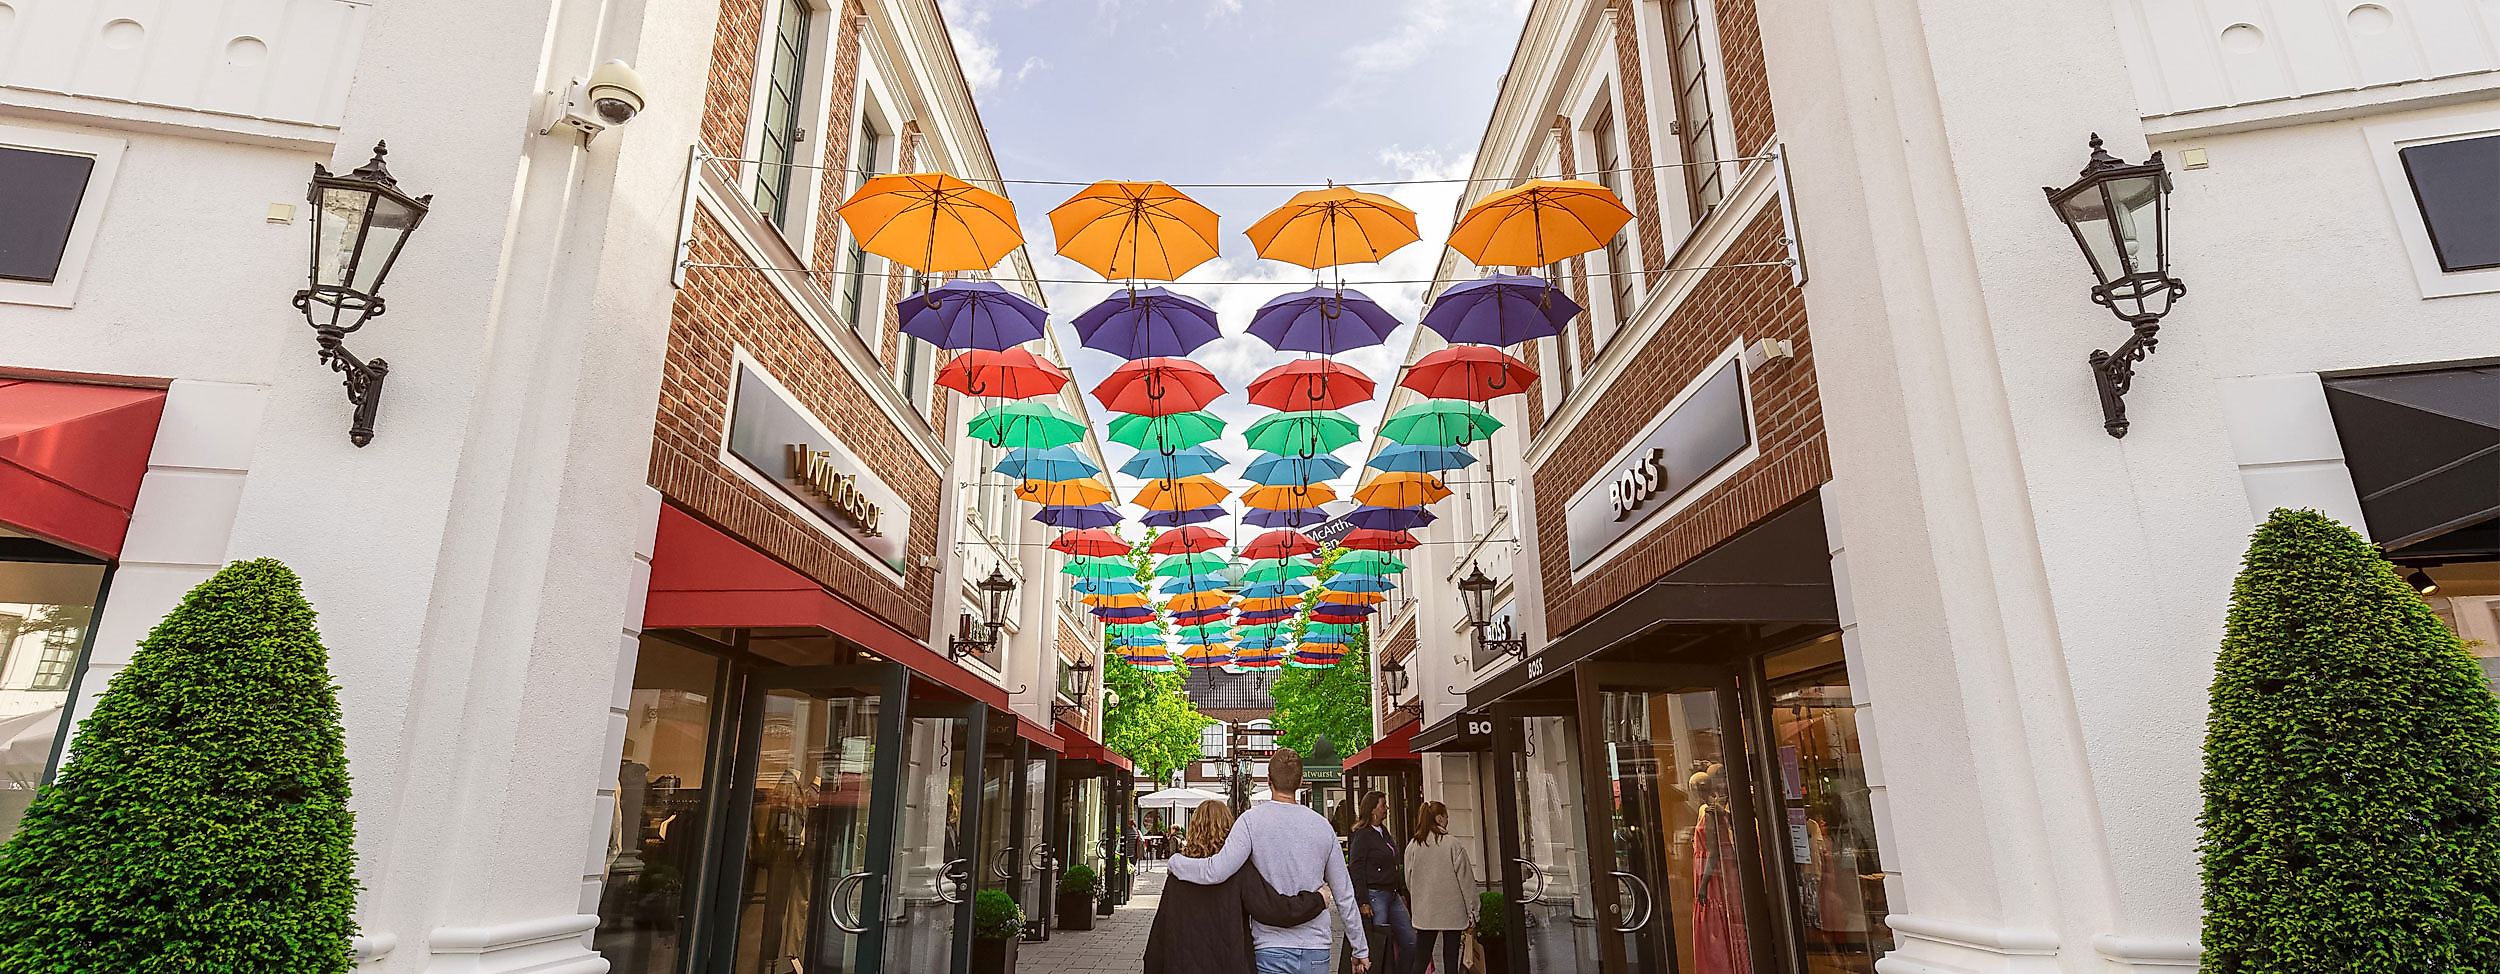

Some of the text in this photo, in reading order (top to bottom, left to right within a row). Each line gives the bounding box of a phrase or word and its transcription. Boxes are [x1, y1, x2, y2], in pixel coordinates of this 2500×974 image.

[1609, 447, 1659, 522] BOSS
[1487, 614, 1507, 649] BOSS
[1528, 657, 1543, 680] BOSS
[1468, 721, 1492, 735] BO
[1303, 770, 1333, 778] atwurst
